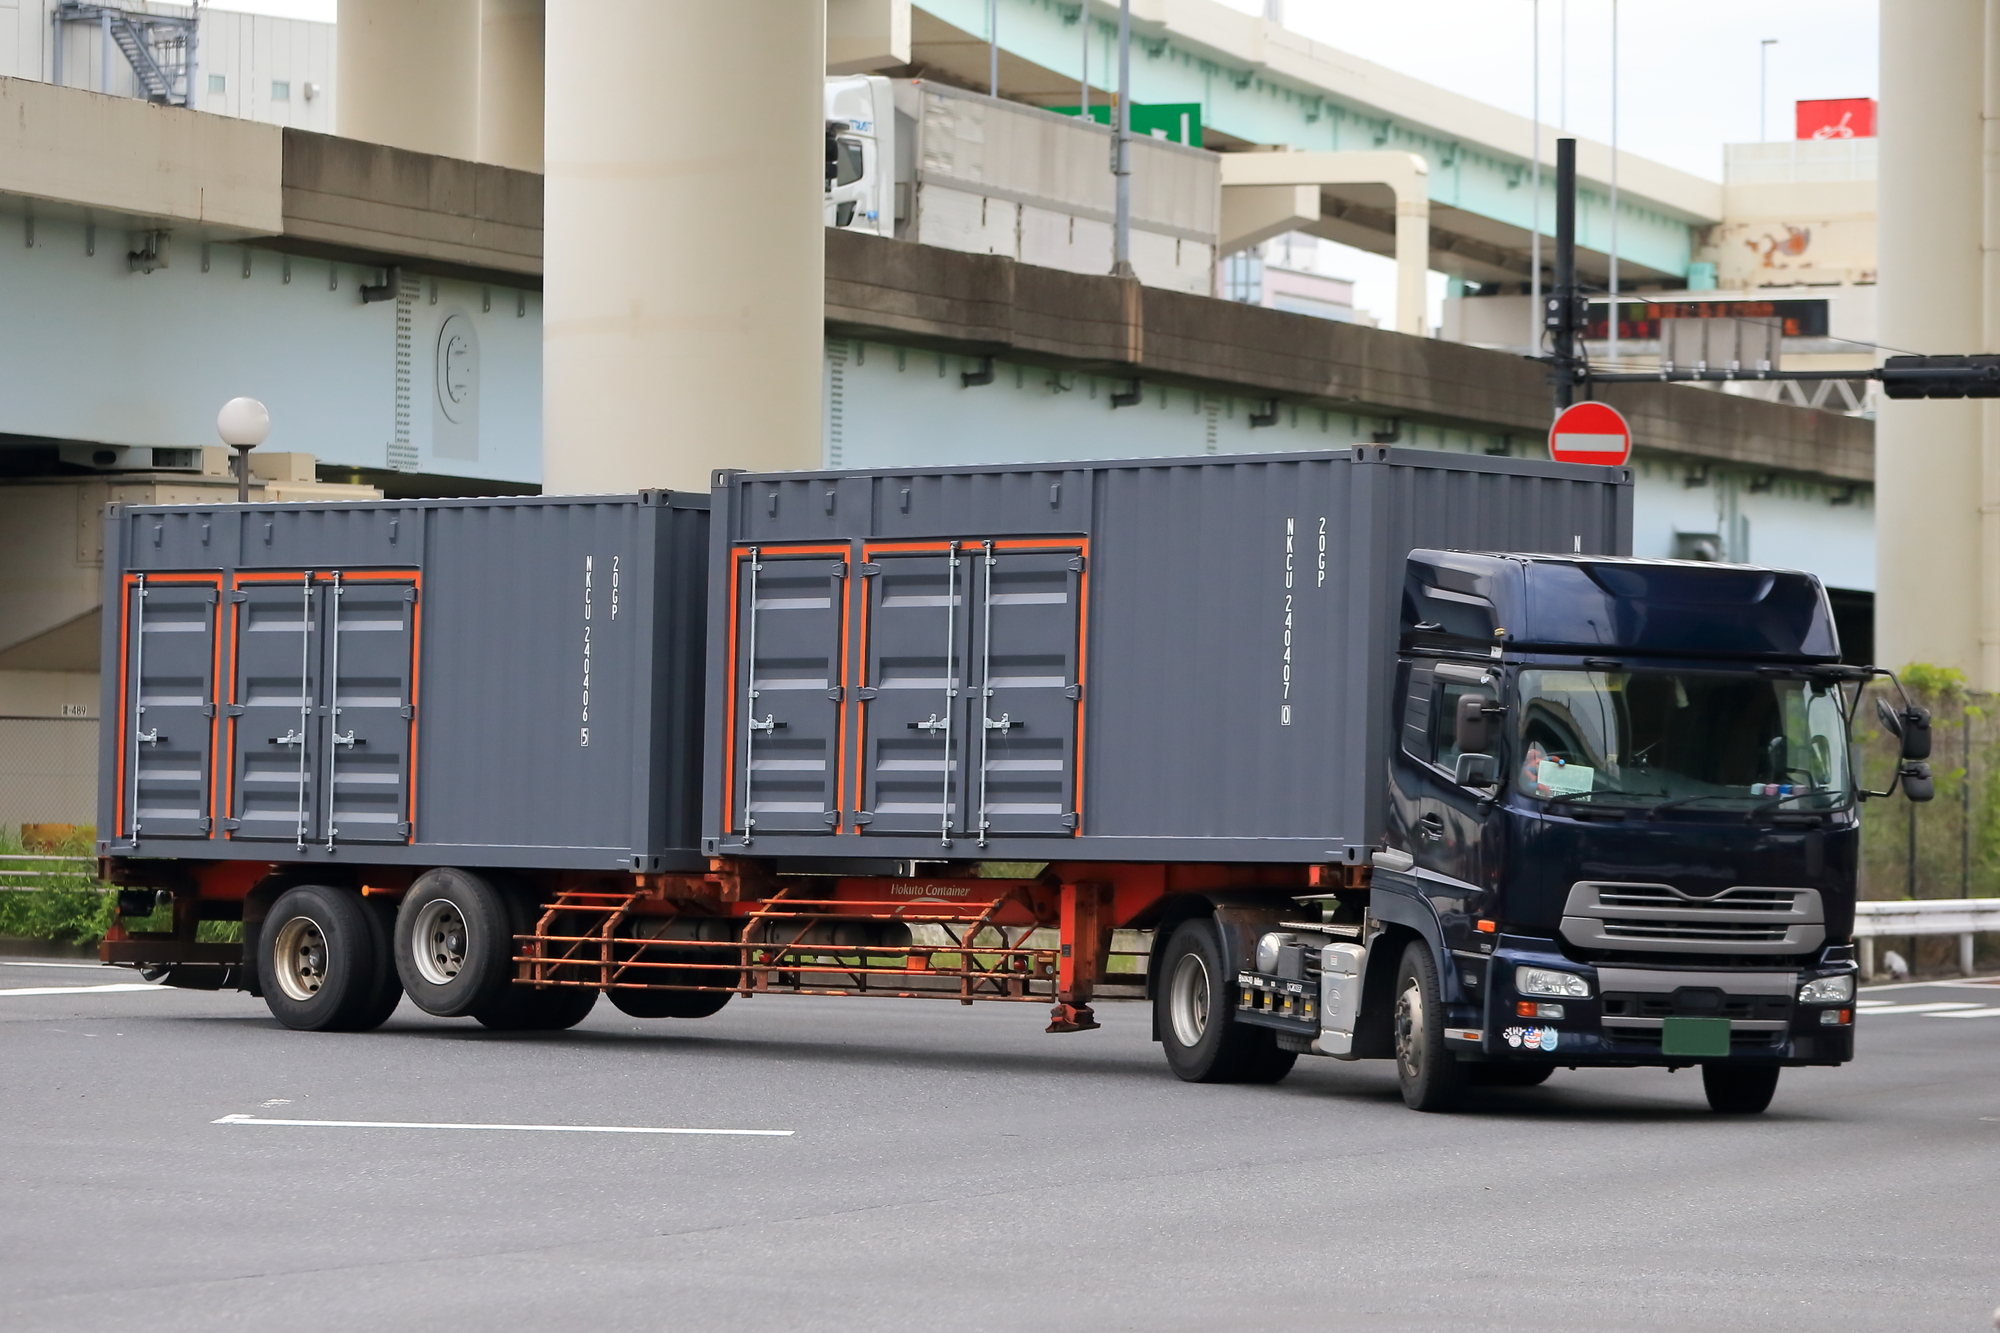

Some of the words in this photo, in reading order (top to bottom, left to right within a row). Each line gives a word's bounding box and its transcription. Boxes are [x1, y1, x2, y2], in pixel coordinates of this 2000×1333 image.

[585, 555, 593, 620] NKCU
[1285, 518, 1294, 589] NKCU
[1317, 516, 1326, 588] 20GP
[611, 555, 619, 621] 20GP
[582, 626, 590, 722] 240406
[1283, 594, 1292, 699] 240407
[890, 883, 923, 895] Hokuto
[925, 884, 970, 896] Container
